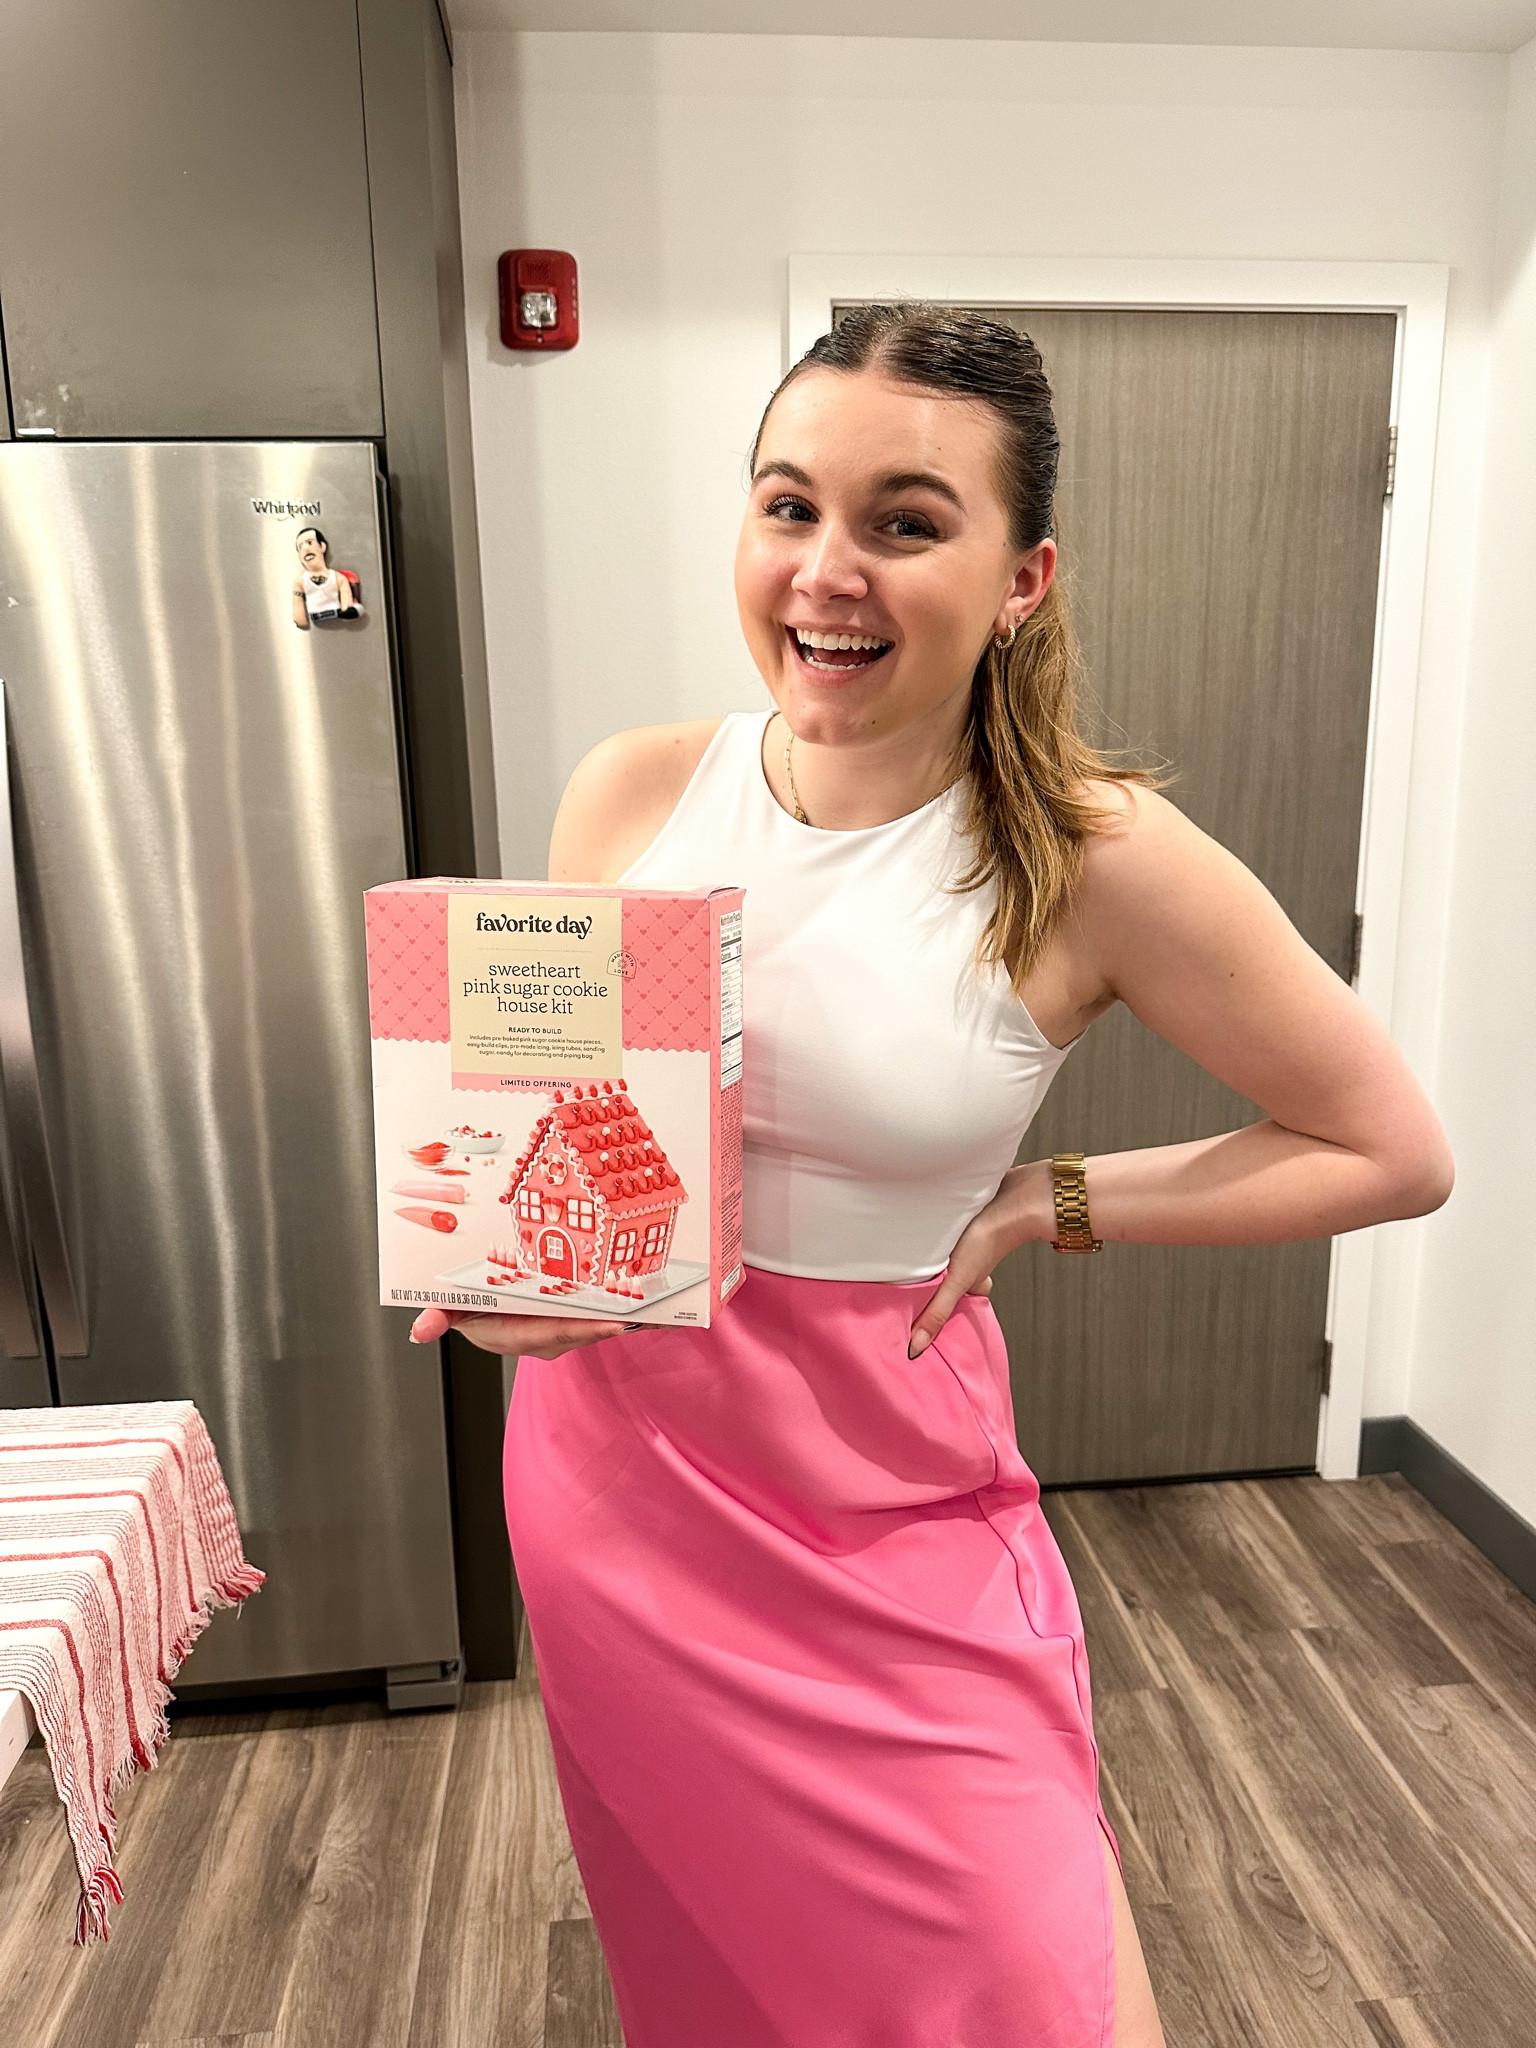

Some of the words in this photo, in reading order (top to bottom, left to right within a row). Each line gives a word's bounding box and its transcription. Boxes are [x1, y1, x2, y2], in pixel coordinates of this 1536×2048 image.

[252, 500, 321, 519] Whirlpool
[476, 912, 552, 933] favorite
[556, 915, 593, 940] day
[488, 962, 581, 979] sweetheart
[463, 978, 500, 997] pink
[503, 983, 550, 999] sugar
[553, 981, 608, 998] cookie
[497, 997, 548, 1014] house
[551, 998, 574, 1015] kit
[496, 1050, 513, 1058] candy
[583, 1046, 605, 1054] sanding
[500, 1079, 531, 1087] LIMITED
[533, 1080, 572, 1089] OFFERING
[391, 1289, 403, 1301] NET
[403, 1290, 413, 1302] WT
[413, 1290, 431, 1303] 24.36
[431, 1291, 440, 1303] OZ
[440, 1292, 447, 1304] (1
[447, 1292, 456, 1304] LB
[456, 1293, 470, 1305] 8.36
[471, 1294, 482, 1306] OZ)
[482, 1294, 498, 1308] 691g
